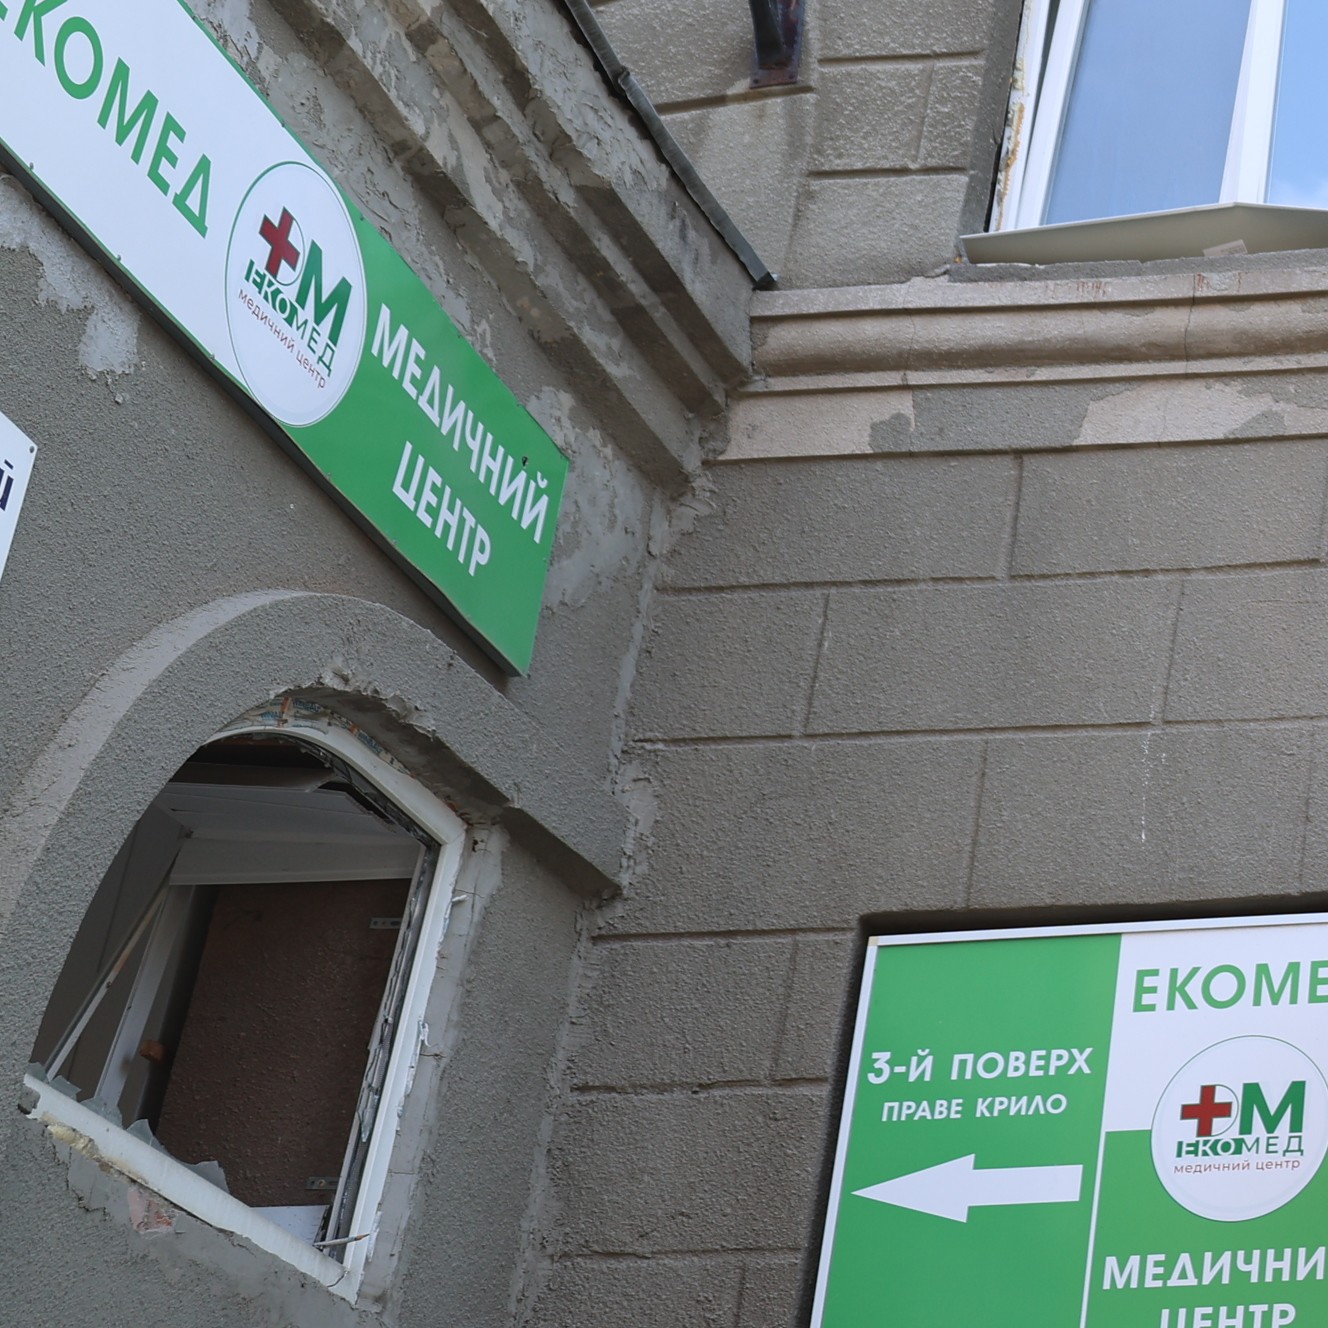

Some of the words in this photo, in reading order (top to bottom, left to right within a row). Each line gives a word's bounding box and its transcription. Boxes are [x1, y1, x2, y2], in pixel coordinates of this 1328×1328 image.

[238, 288, 296, 355] медичний
[296, 348, 327, 389] центр
[370, 303, 549, 545] МЕДИЧНИЙ
[392, 440, 491, 577] ЦЕНТР
[867, 1048, 934, 1085] 3-Й
[950, 1047, 1094, 1080] ПОВЕРХ
[881, 1098, 963, 1122] ПРАВЕ
[975, 1093, 1068, 1118] КРИЛО
[1174, 1159, 1251, 1174] медичний
[1256, 1159, 1301, 1171] центр
